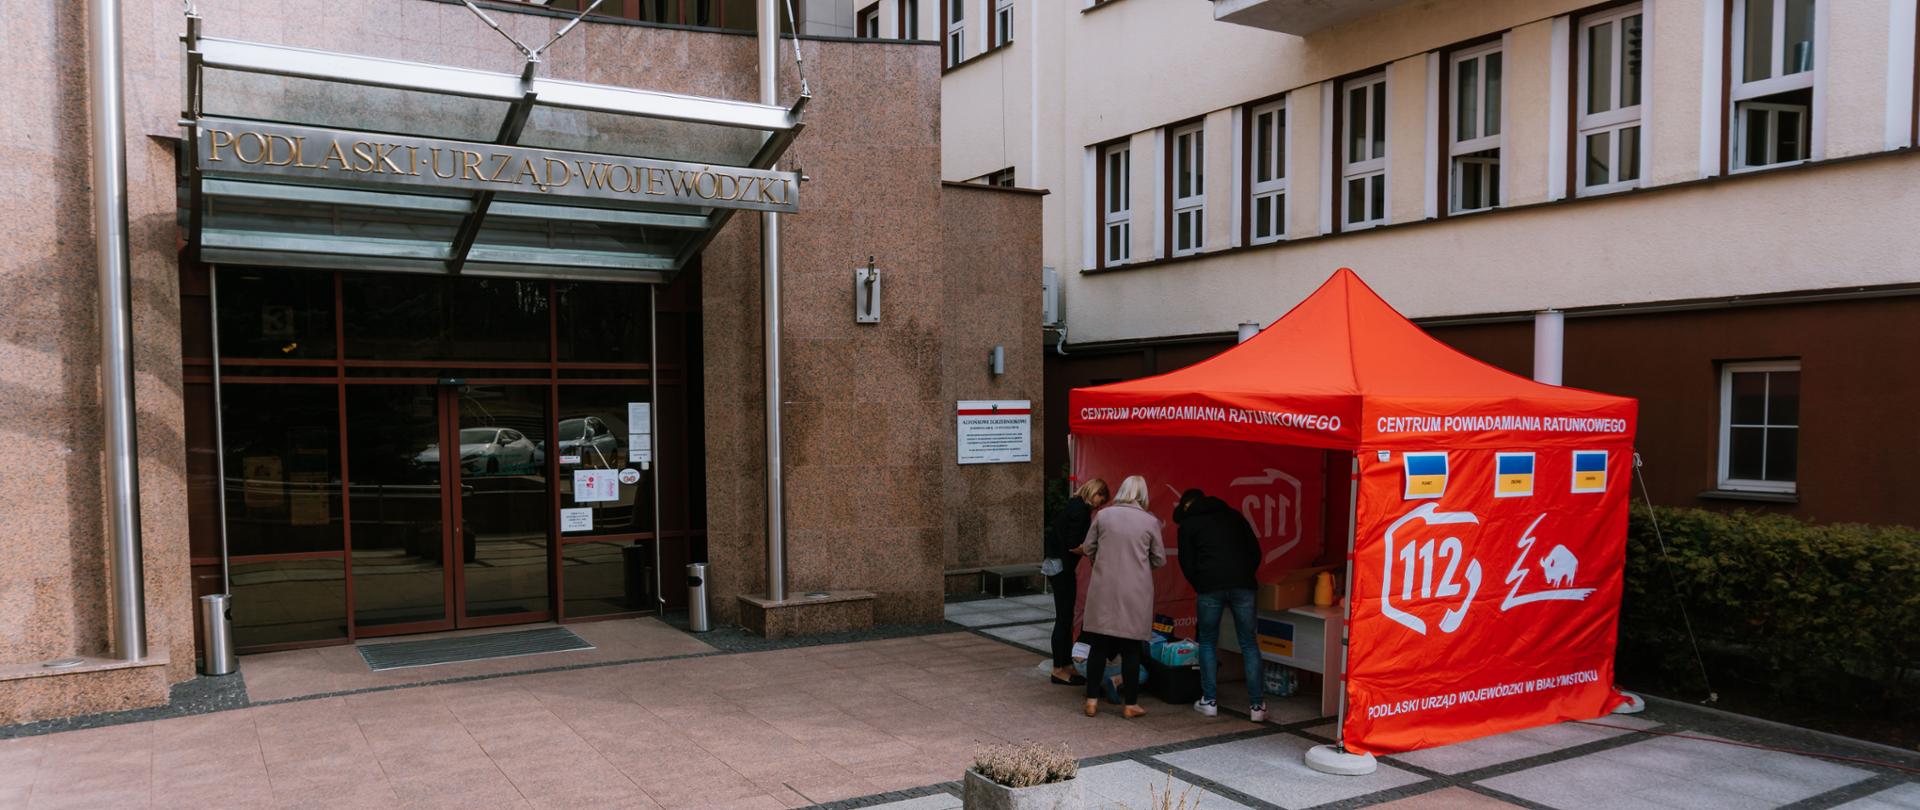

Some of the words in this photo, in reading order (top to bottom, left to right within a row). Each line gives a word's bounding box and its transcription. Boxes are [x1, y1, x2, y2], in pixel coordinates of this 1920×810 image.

[206, 128, 420, 176] PODLASKI
[430, 147, 571, 192] URZĄD
[574, 160, 792, 206] WOJEWÓDZKI
[1080, 407, 1129, 420] CENTRUM
[1131, 406, 1226, 422] POWIADAMIANIA
[1229, 408, 1342, 432] RATUNKOWEGO
[1377, 416, 1441, 433] CENTRUM
[1444, 415, 1541, 432] POWIADAMIANIA
[1543, 416, 1627, 433] RATUNKOWEGO
[1400, 537, 1462, 600] 112
[1367, 698, 1420, 719] PODLASKI
[1421, 693, 1457, 710] URZĄD
[1459, 682, 1524, 704] WOJEWÓDZKI
[1526, 680, 1535, 693] W
[1536, 669, 1599, 692] BIAŁYMSTOKU
